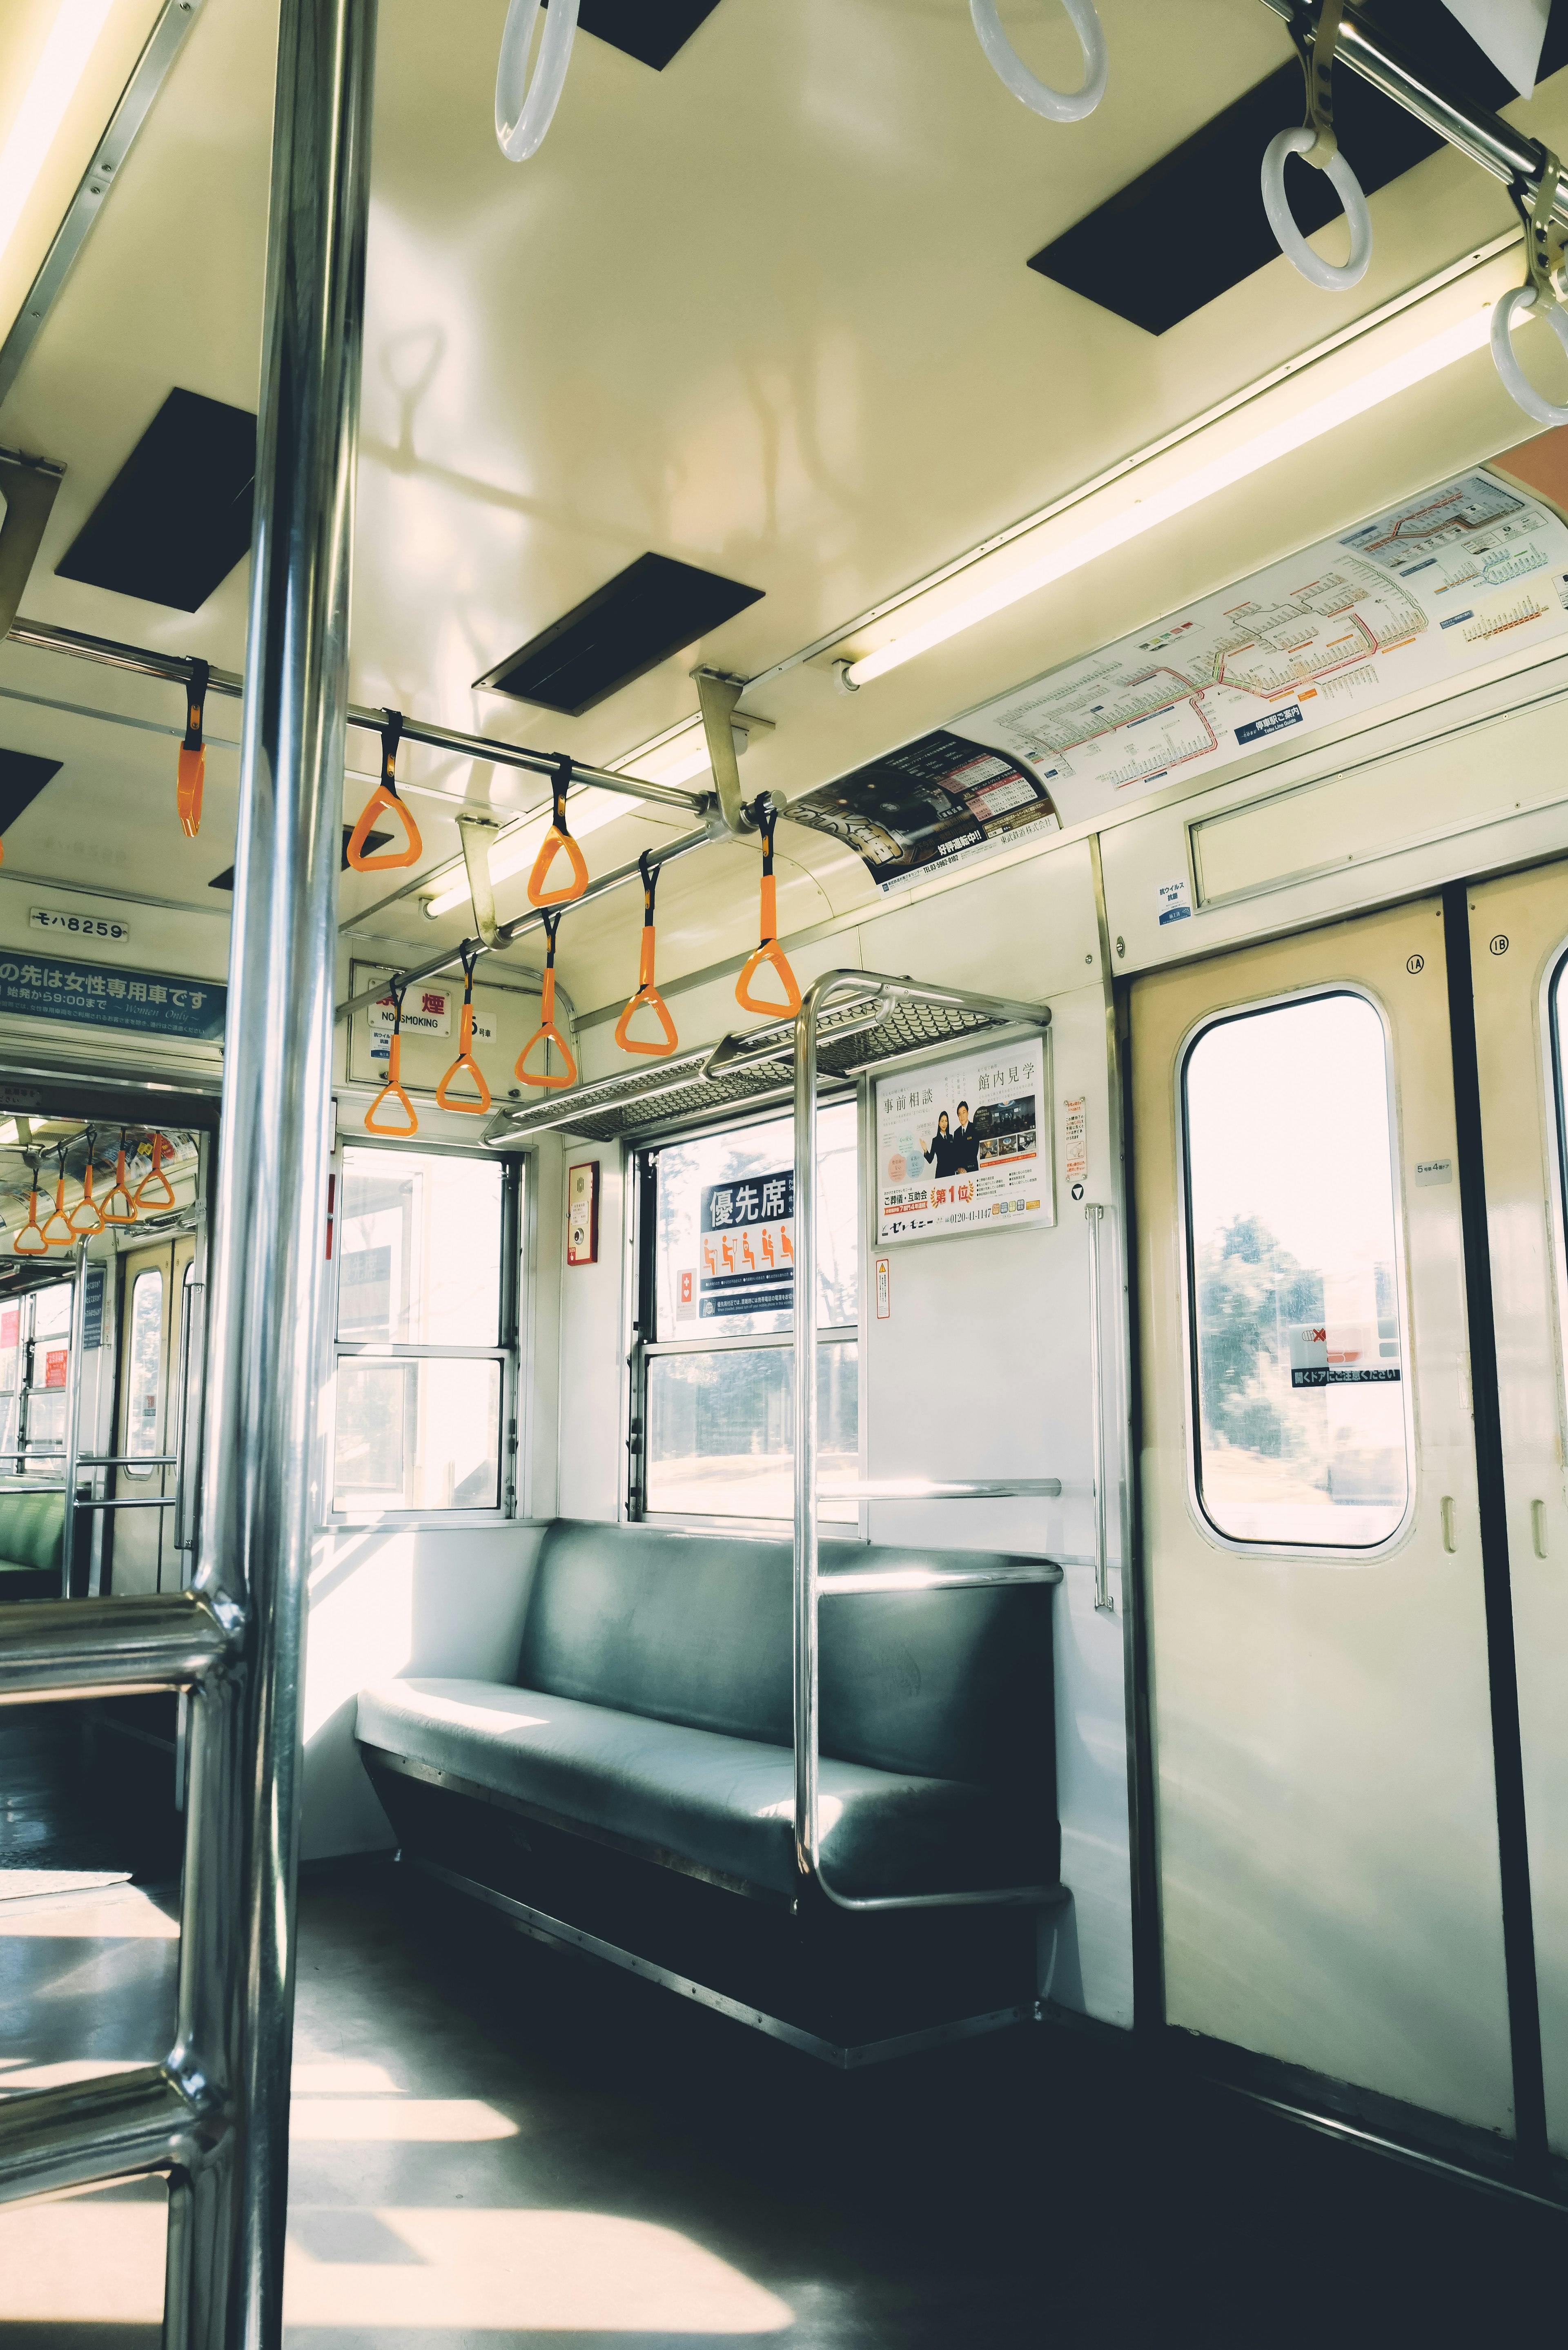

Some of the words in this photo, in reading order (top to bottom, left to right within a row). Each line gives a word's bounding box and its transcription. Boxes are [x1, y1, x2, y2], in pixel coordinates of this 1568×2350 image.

[1256, 707, 1300, 731] 停車駅ご案内
[942, 805, 963, 818] 運転区間
[1000, 818, 1051, 845] 東武鉄道株式会社
[938, 830, 982, 856] 好評運転中!!
[923, 855, 959, 874] TEL.03-5962-0102
[1160, 882, 1184, 895] 抗ウイルス
[1168, 893, 1178, 901] 抗菌
[36, 912, 122, 938] モハ8259
[0, 963, 207, 1009] の先は女性専用車です
[7, 985, 107, 1010] 始発から9:00まで
[382, 1012, 395, 1021] NO
[401, 1015, 438, 1028] SMOKING
[978, 1062, 1034, 1091] 館内見学
[883, 1088, 933, 1114] 事前相談
[710, 1179, 786, 1227] 優先席
[884, 1189, 927, 1206] ご葬儀・互助会
[935, 1185, 970, 1205] 第1位
[950, 1208, 991, 1224] 0120-41-1147
[890, 1219, 933, 1234] セレモニー
[1294, 1369, 1396, 1384] 開くドアにご注意ください
